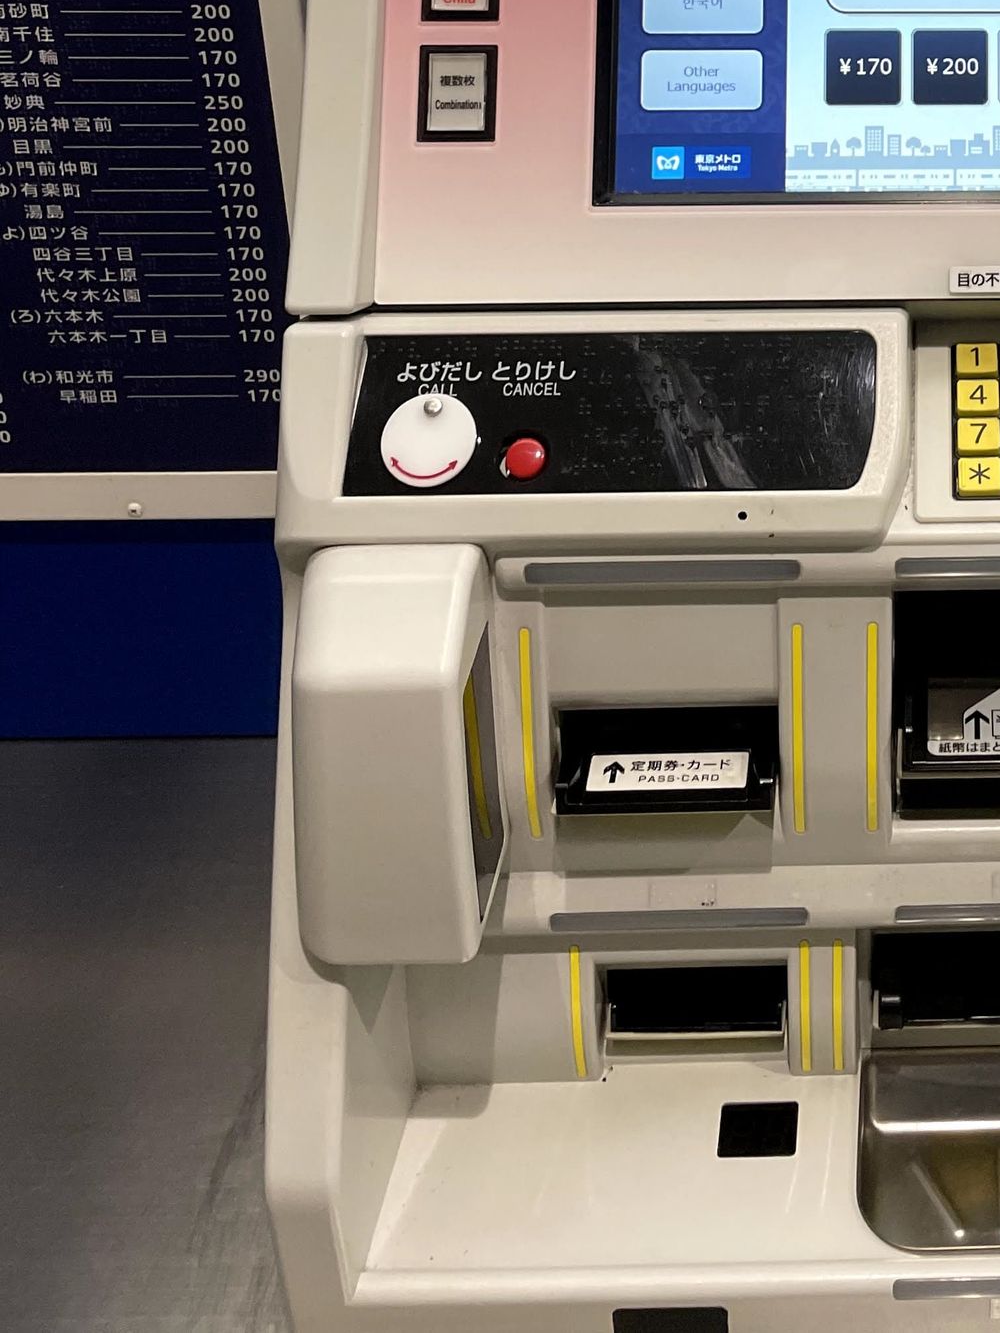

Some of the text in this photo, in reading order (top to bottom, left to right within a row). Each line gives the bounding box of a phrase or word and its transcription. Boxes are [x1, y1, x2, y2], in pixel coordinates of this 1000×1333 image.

[198, 51, 237, 65] 170
[683, 66, 720, 78] Other
[839, 57, 893, 76] ¥170
[926, 57, 980, 76] ¥200
[0, 72, 240, 88] 茗荷谷 170
[440, 74, 476, 88] 複数枚
[667, 79, 736, 94] Languages
[4, 95, 243, 110] 妙典 250
[207, 118, 246, 132] 200
[13, 139, 249, 154] 目黒 200
[695, 154, 741, 164] 東京メトロ
[214, 162, 252, 176] 170
[217, 184, 255, 197] 170
[24, 204, 258, 219] 湯島 170
[223, 227, 261, 240] 170
[33, 247, 264, 261] 四谷三丁目 170
[37, 268, 267, 282] 代々木上原 200
[41, 289, 270, 303] 代々木公園 200
[236, 310, 273, 322] 170
[48, 330, 275, 343] 六本木一丁目 170
[969, 347, 980, 366] 1
[243, 369, 281, 383] 290
[397, 360, 577, 383] よびだし とりけし
[60, 389, 282, 404] 早稲田 170
[418, 382, 562, 397] CALL CANCEL
[969, 385, 988, 404] 4
[970, 423, 988, 444] 7
[630, 758, 733, 772] 定期券・カード
